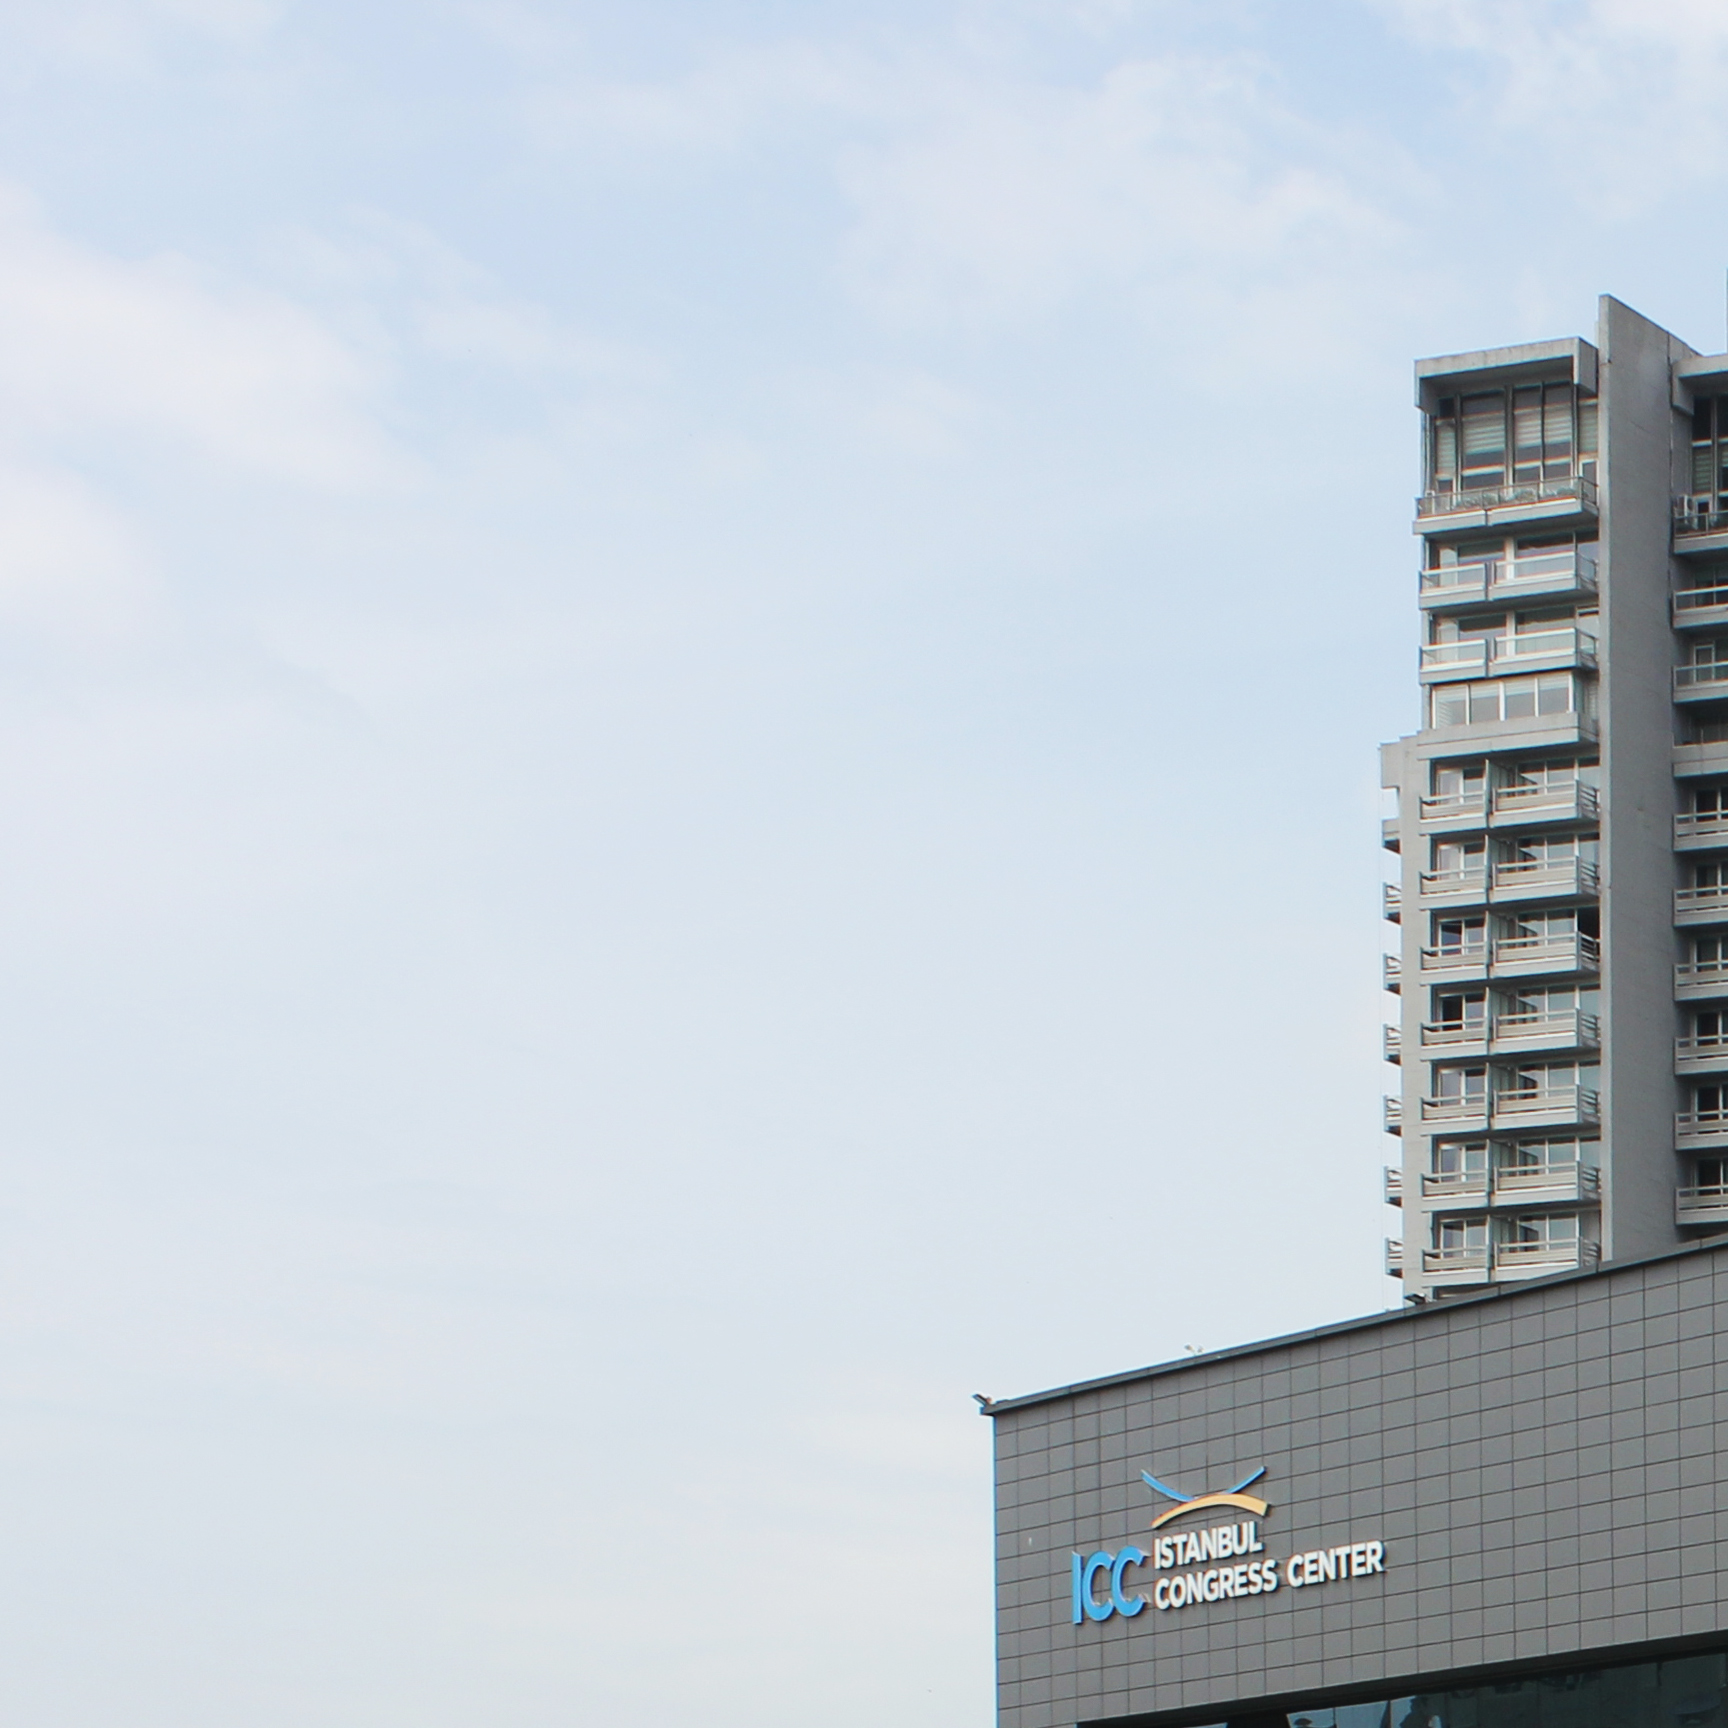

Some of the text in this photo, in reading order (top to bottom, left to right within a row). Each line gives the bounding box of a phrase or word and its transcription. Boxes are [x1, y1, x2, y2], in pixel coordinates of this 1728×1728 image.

[1154, 1521, 1264, 1570] ISTANBUL
[1154, 1540, 1386, 1611] CONGRESS CENTER
[1072, 1546, 1146, 1625] ICC
